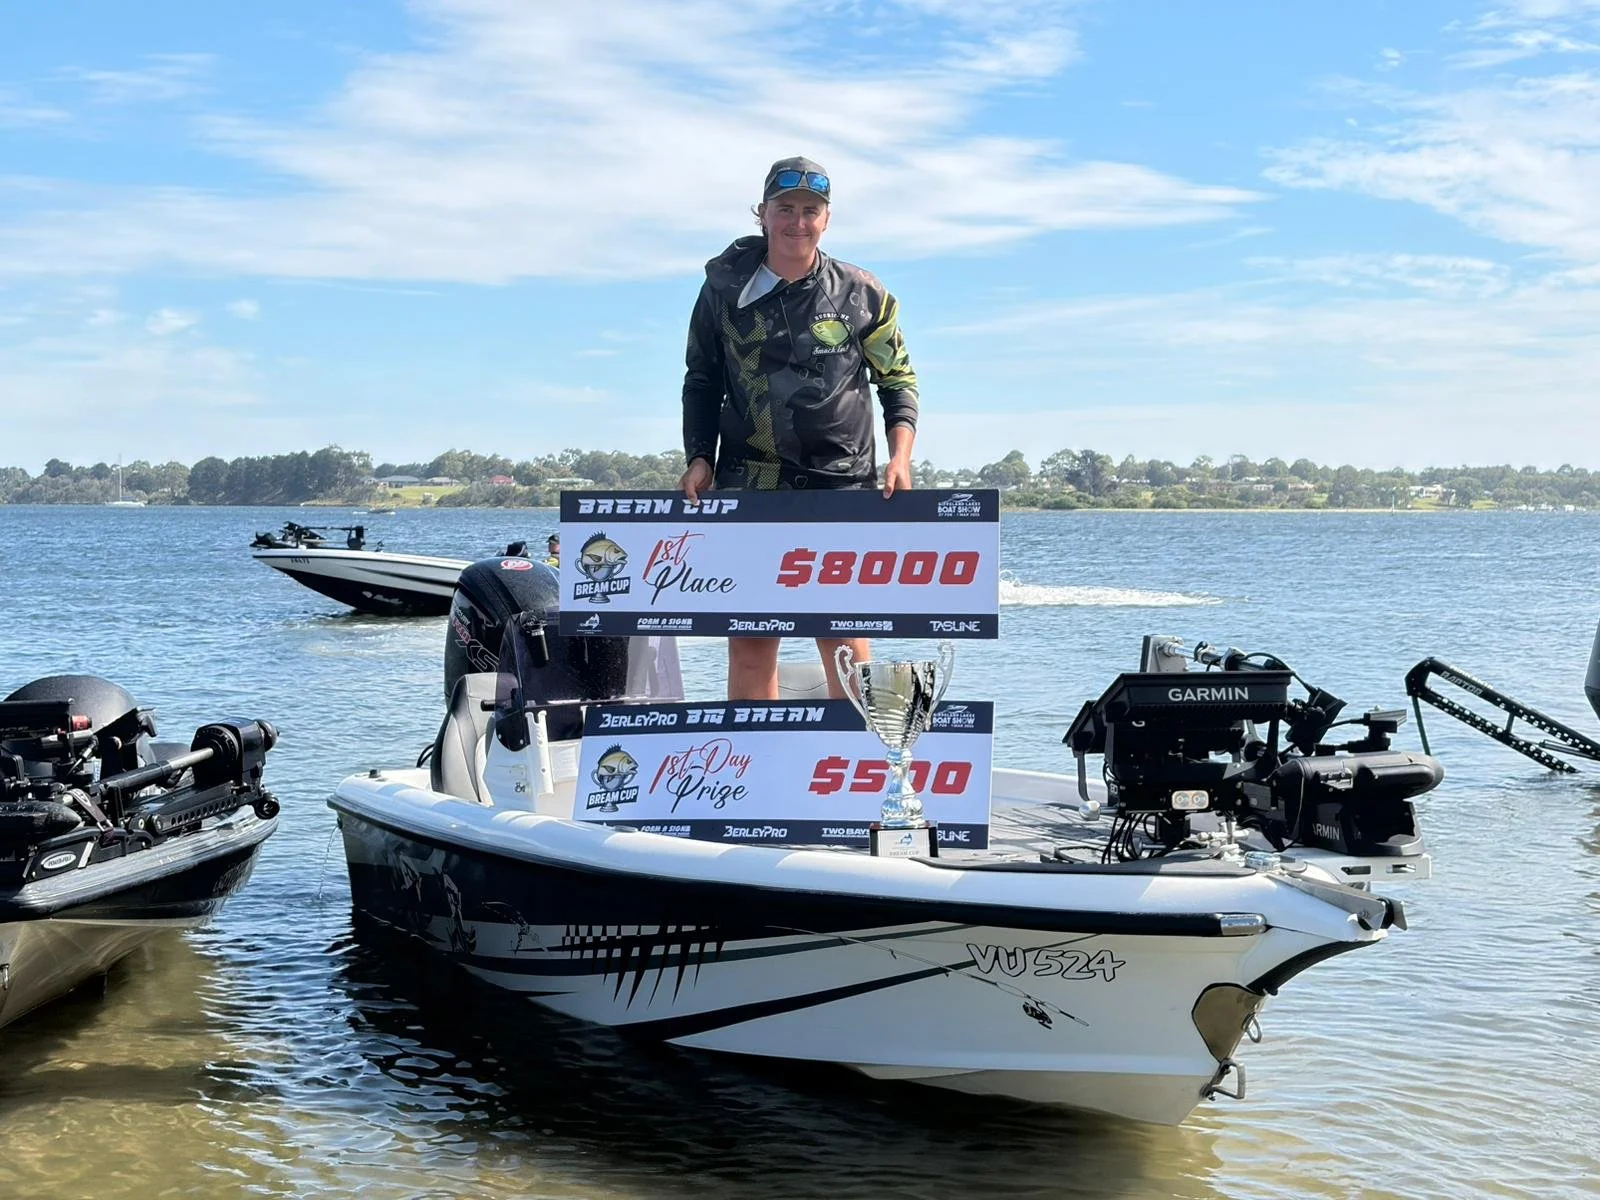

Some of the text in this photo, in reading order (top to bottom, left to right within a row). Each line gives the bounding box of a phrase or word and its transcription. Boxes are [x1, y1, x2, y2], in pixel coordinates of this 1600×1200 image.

[577, 498, 739, 514] BREAM CUP
[642, 530, 705, 580] 1st
[776, 547, 980, 588] $8000
[575, 578, 630, 596] BREAM CUP
[644, 557, 737, 605] Place
[830, 620, 883, 628] TWO BAYS
[1440, 670, 1484, 696] RAPTOR
[1168, 687, 1249, 702] GARMIN
[686, 708, 726, 725] BIG
[734, 707, 825, 723] BREAM
[700, 738, 752, 779] Day
[589, 788, 638, 806] BREAM CUP
[666, 765, 748, 814] Prize
[822, 827, 846, 835] TWO
[966, 943, 1126, 982] VU 524
